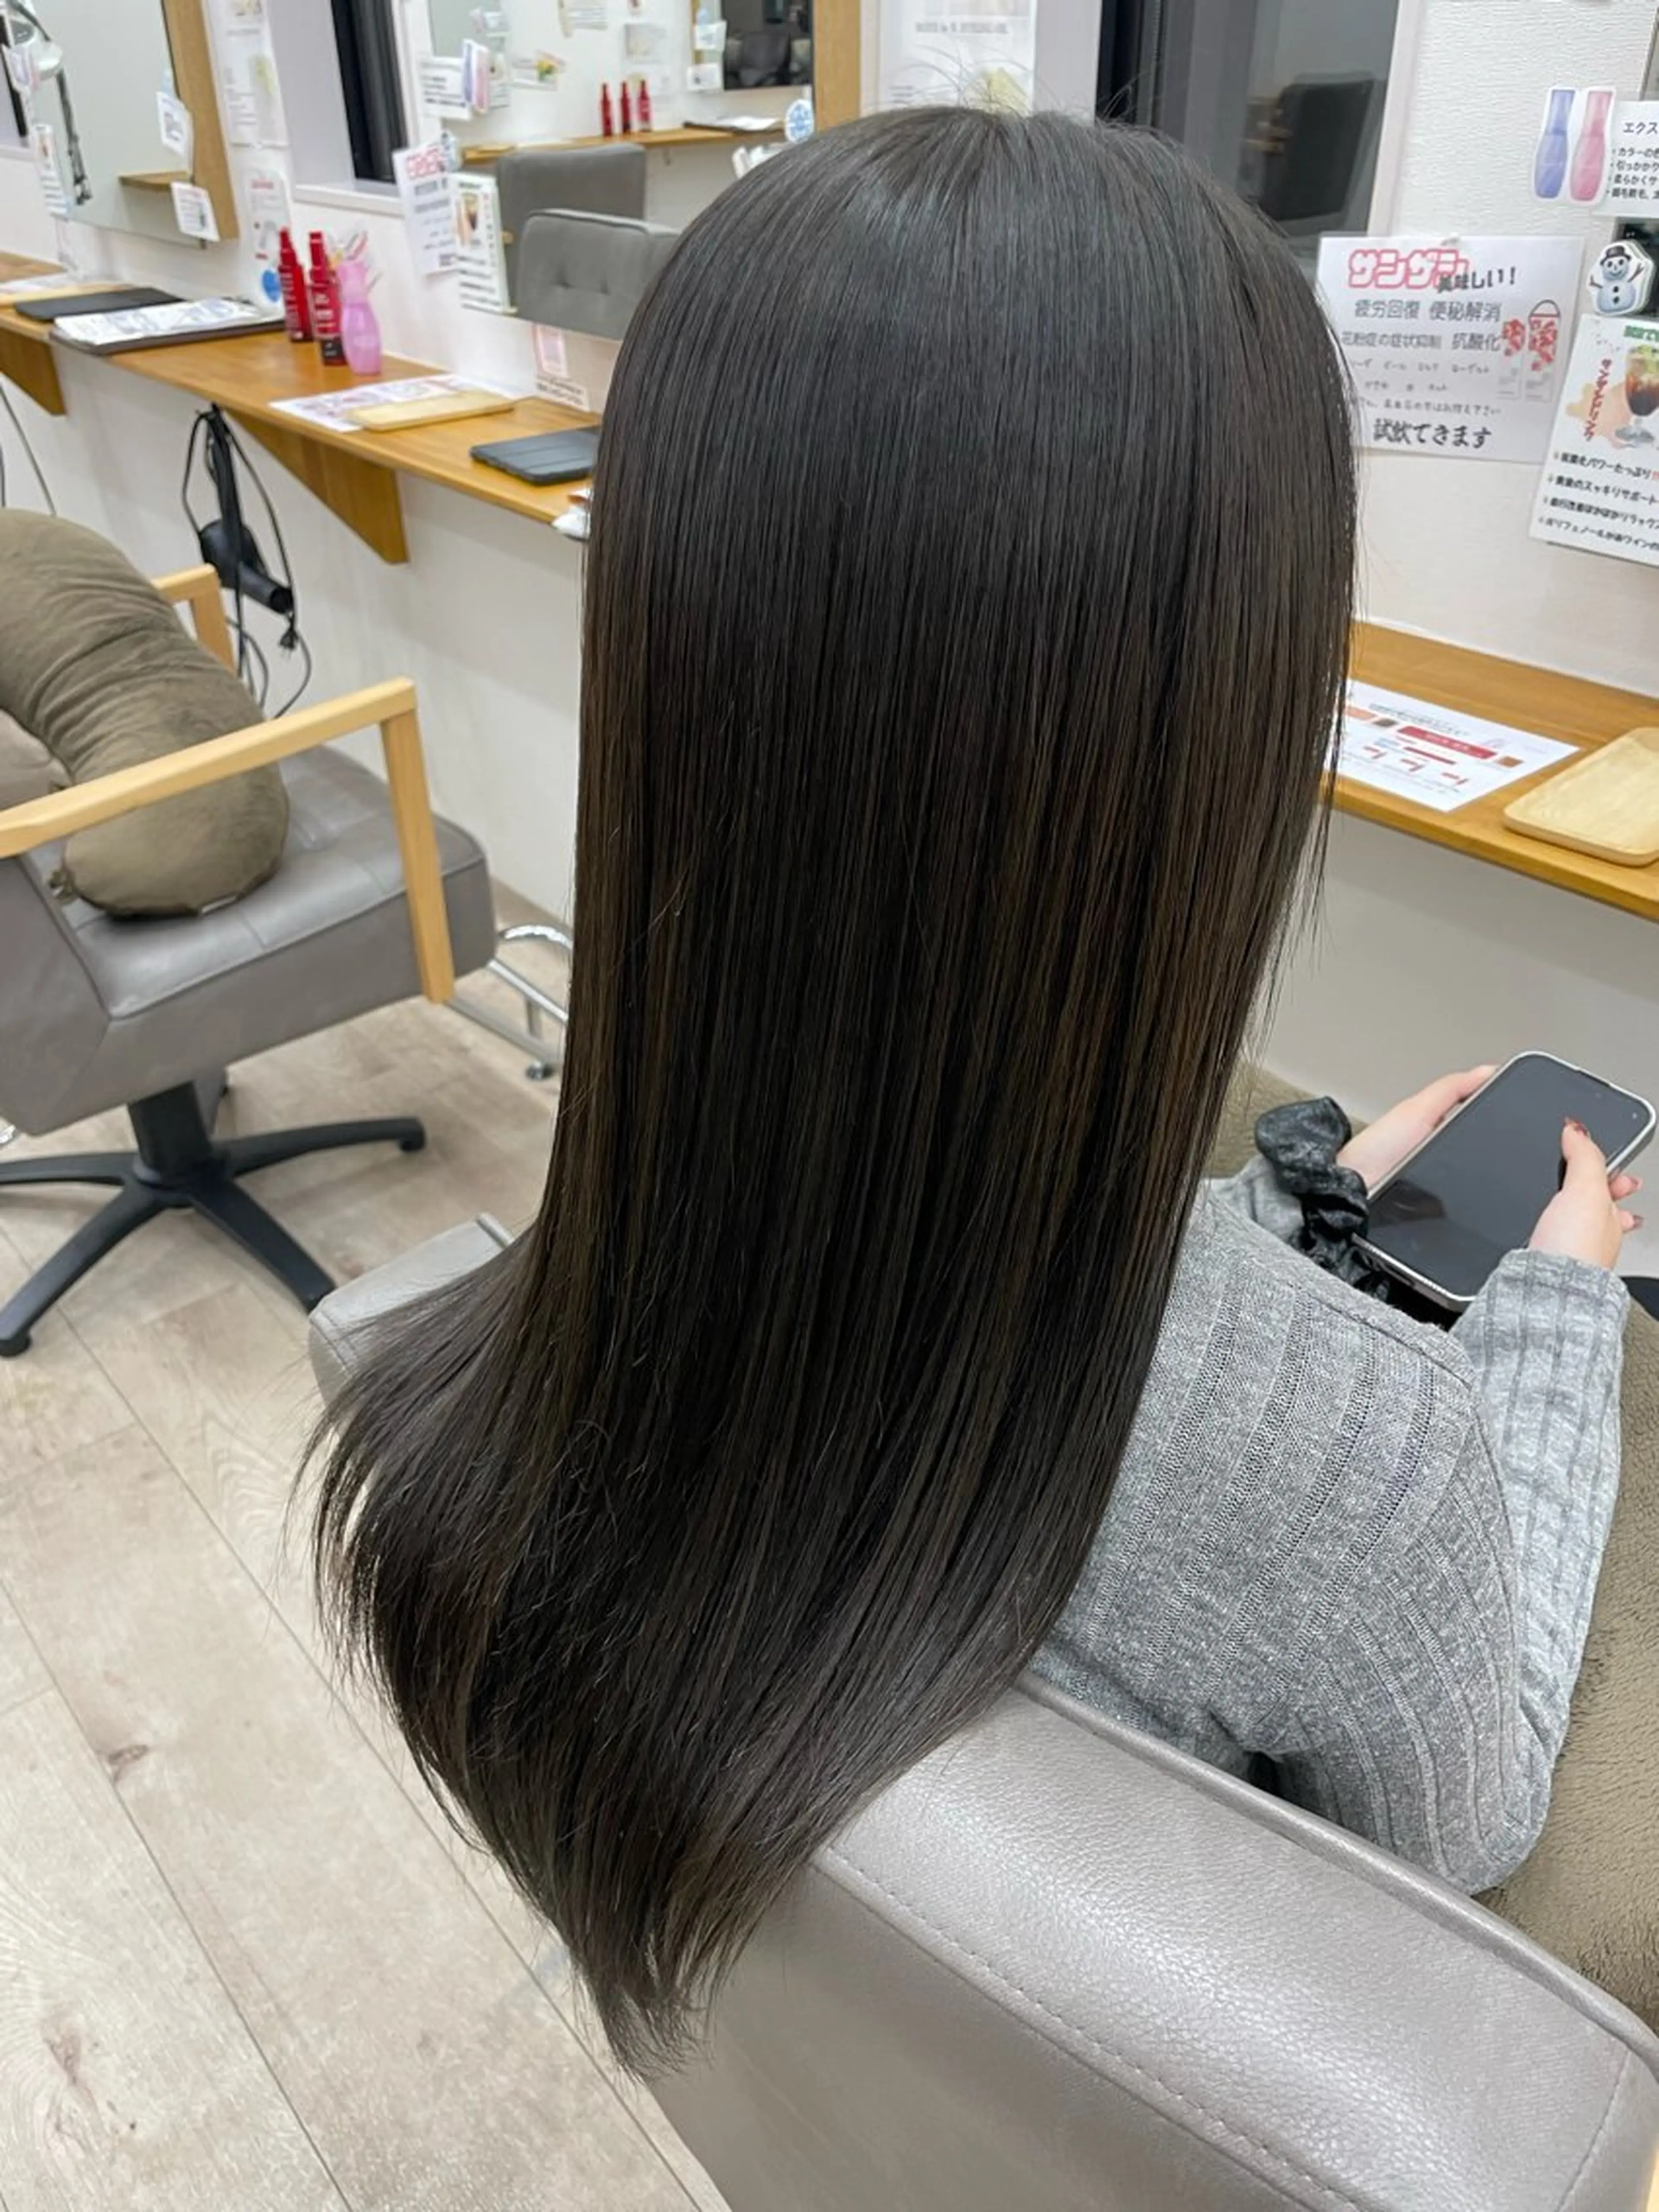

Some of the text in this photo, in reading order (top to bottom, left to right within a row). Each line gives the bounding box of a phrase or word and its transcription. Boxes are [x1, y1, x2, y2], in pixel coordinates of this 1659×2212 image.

[1623, 122, 1658, 135] エクス
[1355, 299, 1501, 322] 疲労回復 便秘解消
